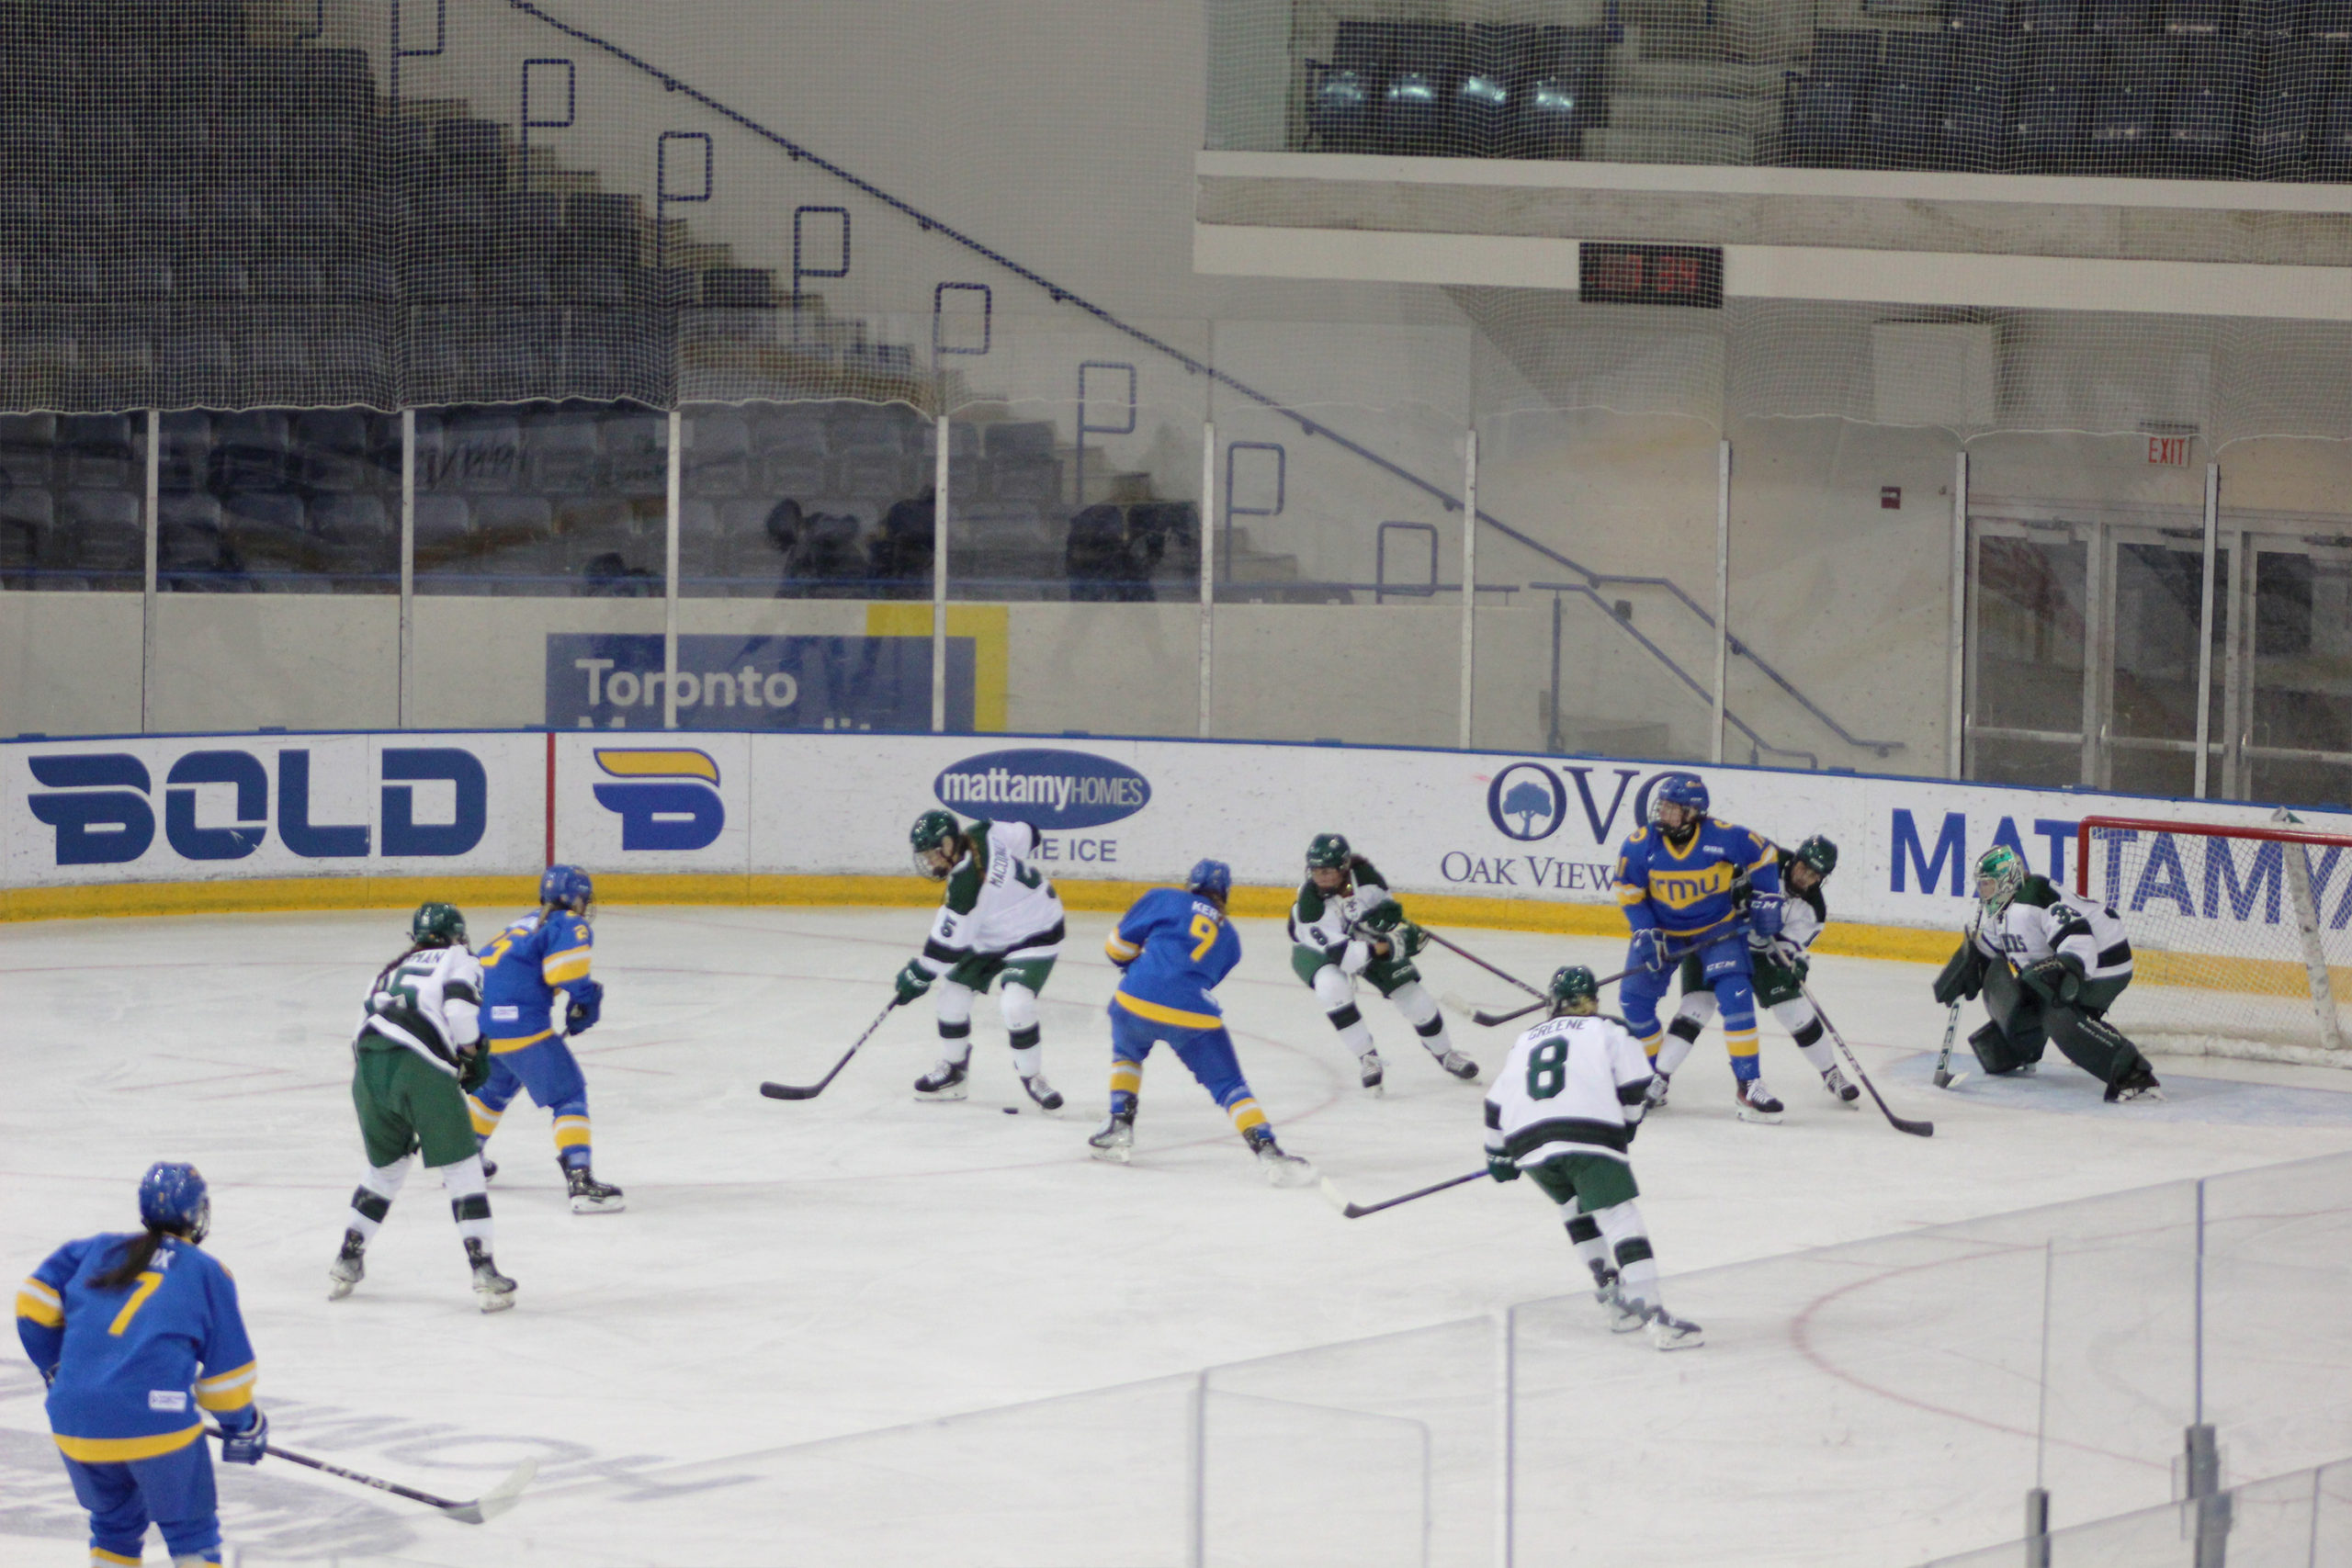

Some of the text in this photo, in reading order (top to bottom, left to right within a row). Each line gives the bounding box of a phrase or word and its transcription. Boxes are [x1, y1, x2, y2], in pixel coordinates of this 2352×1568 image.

[2149, 436, 2185, 466] EXIT
[575, 659, 797, 706] Toronto
[28, 748, 488, 865] BOLD
[1069, 839, 1117, 862] ICE
[1441, 852, 1517, 885] OAK
[1189, 913, 1218, 962] 9
[1528, 1019, 1589, 1040] GREENE
[1527, 1034, 1569, 1100] 8
[107, 1271, 164, 1336] 7
